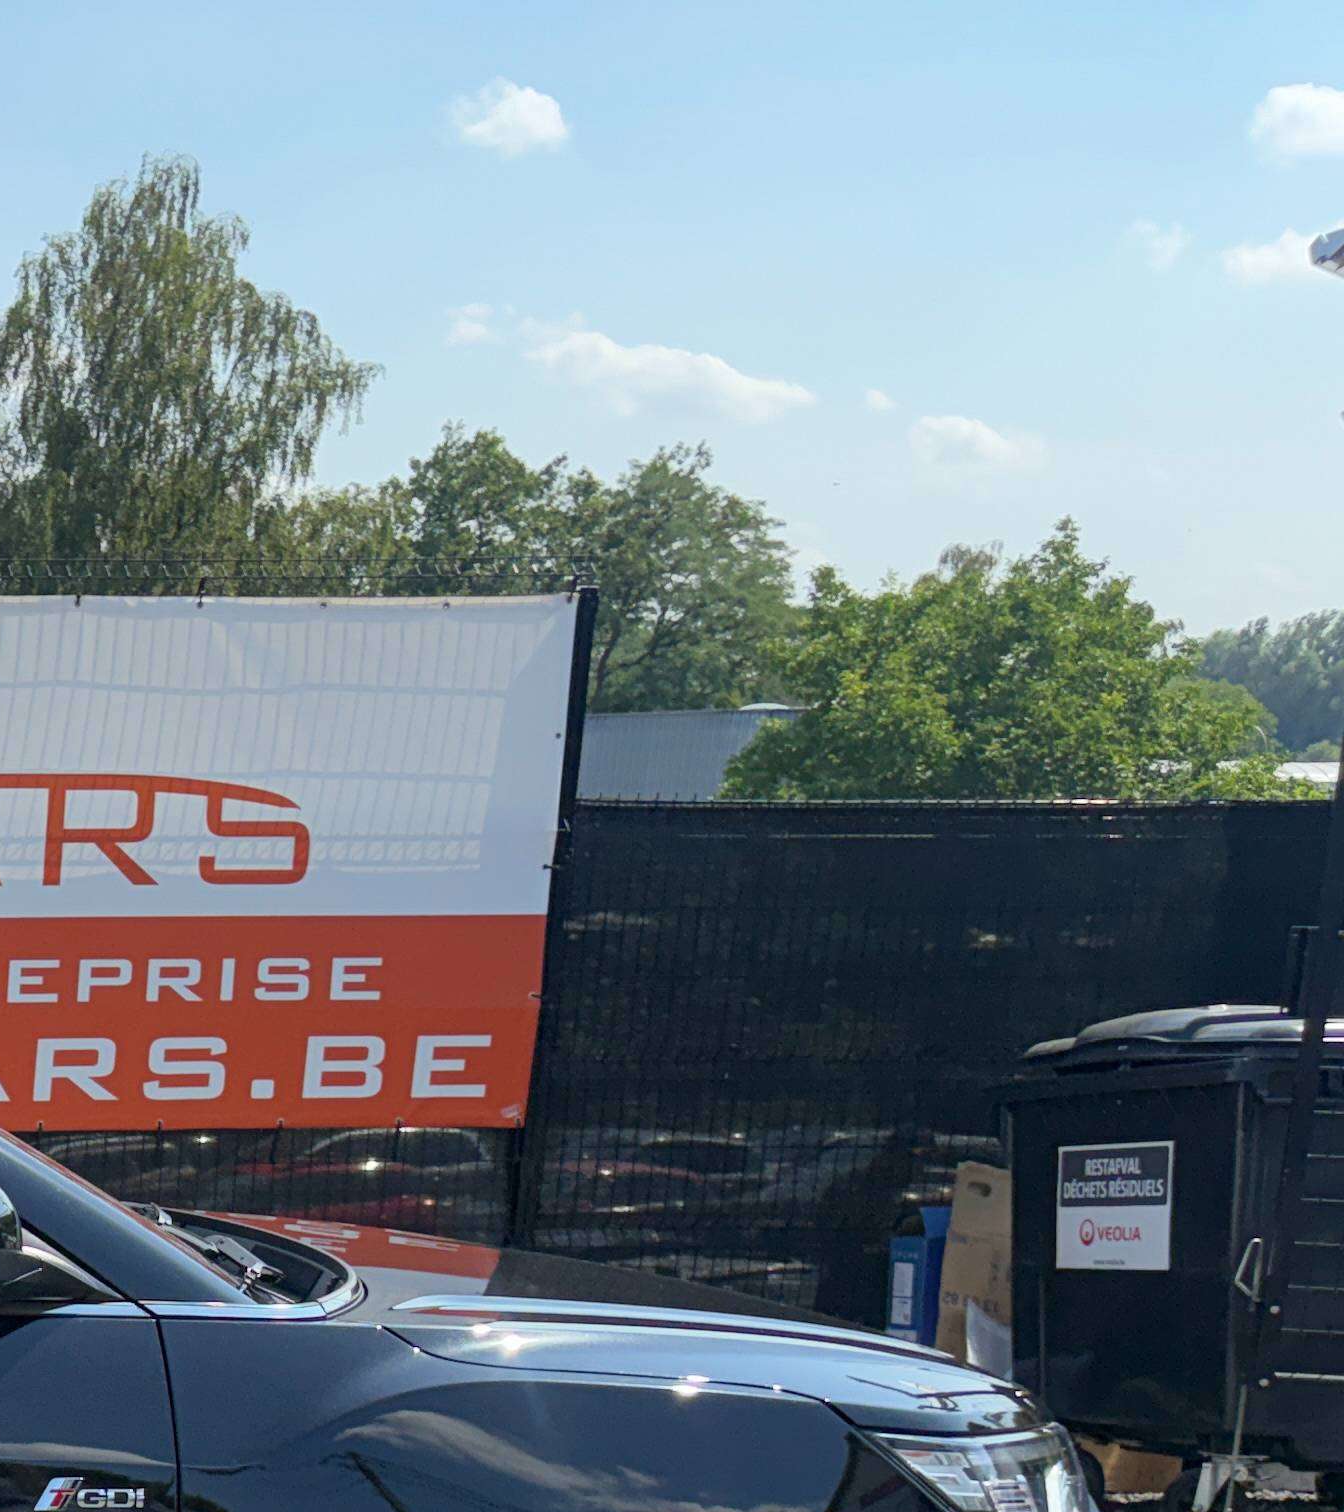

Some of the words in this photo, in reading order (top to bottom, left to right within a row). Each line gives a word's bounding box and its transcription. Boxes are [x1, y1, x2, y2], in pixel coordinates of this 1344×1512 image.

[1085, 1158, 1141, 1176] RESTAFVAL
[1063, 1179, 1107, 1199] DÉCHETS
[1109, 1177, 1164, 1198] RÉSIDUELS
[1097, 1226, 1141, 1241] VEOLIA
